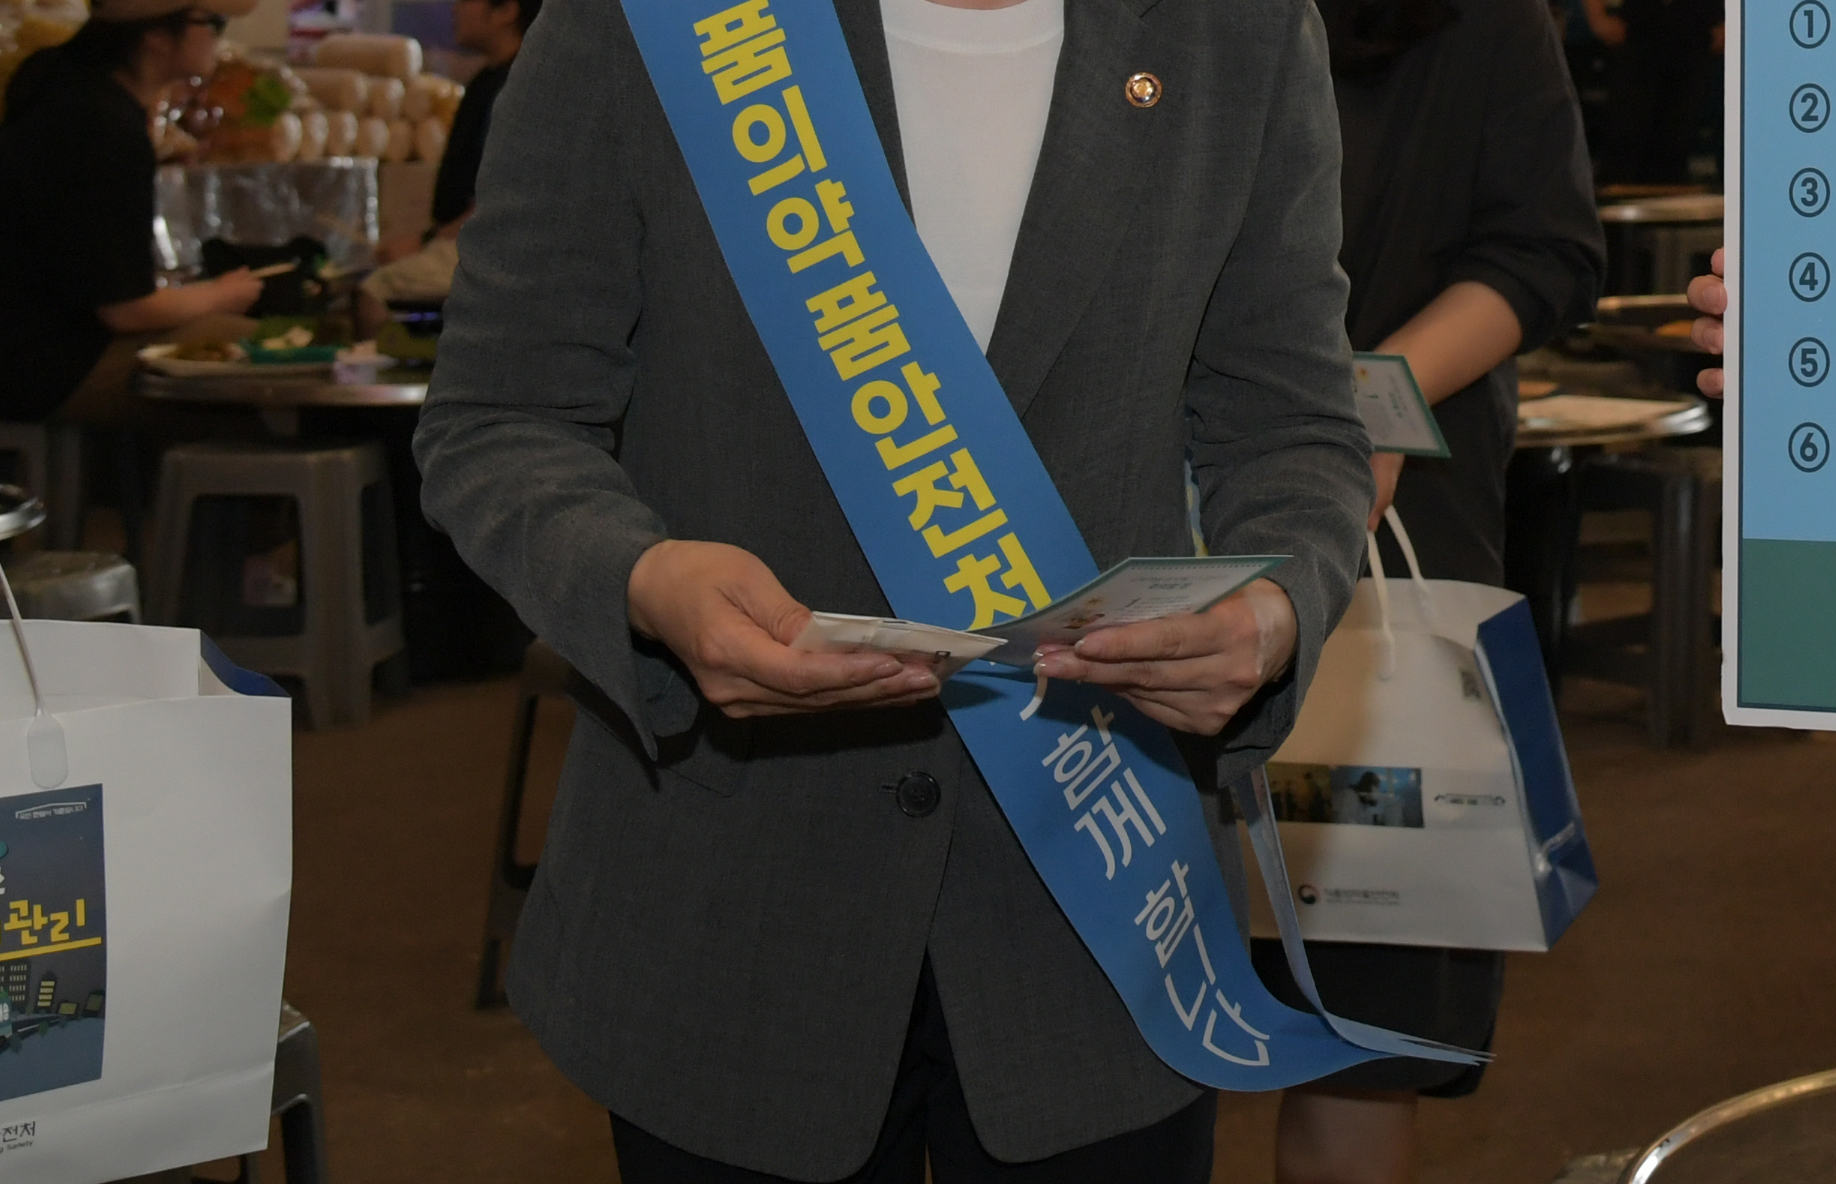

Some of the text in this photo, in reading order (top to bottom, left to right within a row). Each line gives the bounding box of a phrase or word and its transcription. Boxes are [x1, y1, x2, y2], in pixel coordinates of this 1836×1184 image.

[1041, 705, 1167, 881] 함께
[1133, 859, 1271, 1067] 합니다
[0, 898, 86, 946] 관리
[0, 1120, 36, 1143] 전처
